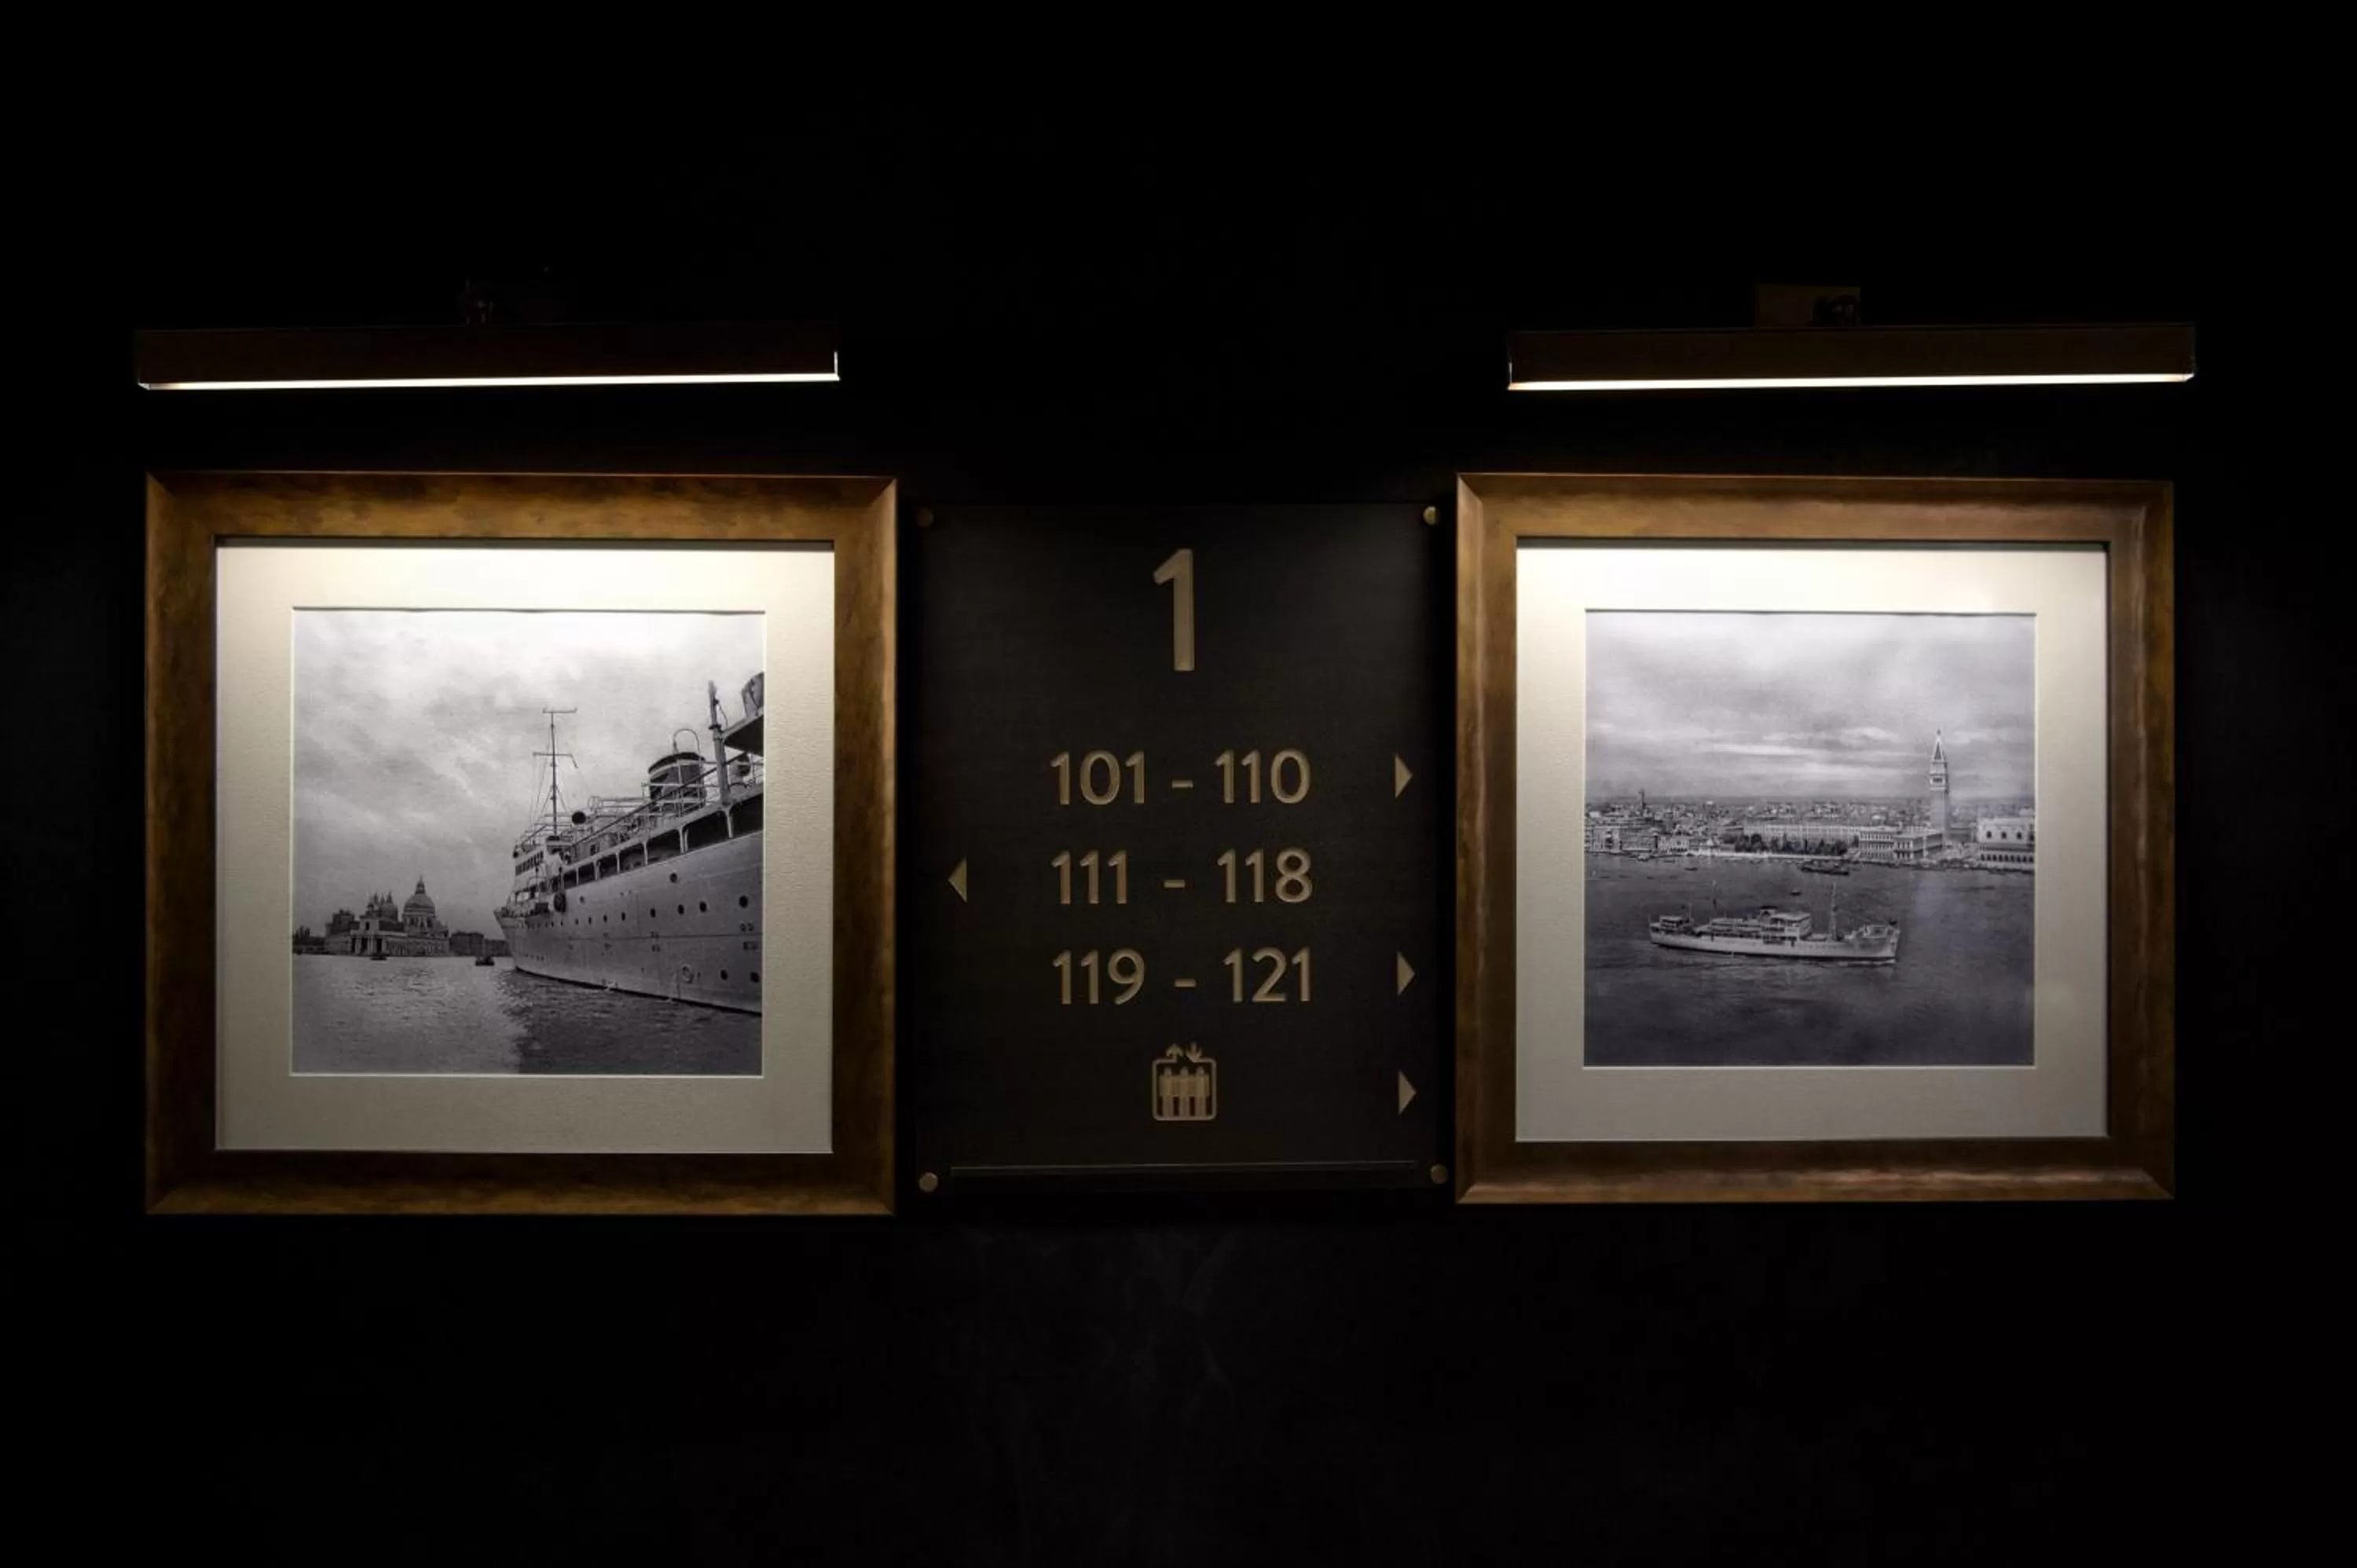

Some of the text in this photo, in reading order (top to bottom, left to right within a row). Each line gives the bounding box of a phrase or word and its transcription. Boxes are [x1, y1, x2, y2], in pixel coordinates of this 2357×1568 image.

[1153, 548, 1196, 672] 1
[1050, 749, 1311, 806] 101 - 110
[1051, 849, 1314, 905] 111 - 118
[1053, 947, 1312, 1006] 119 - 121
